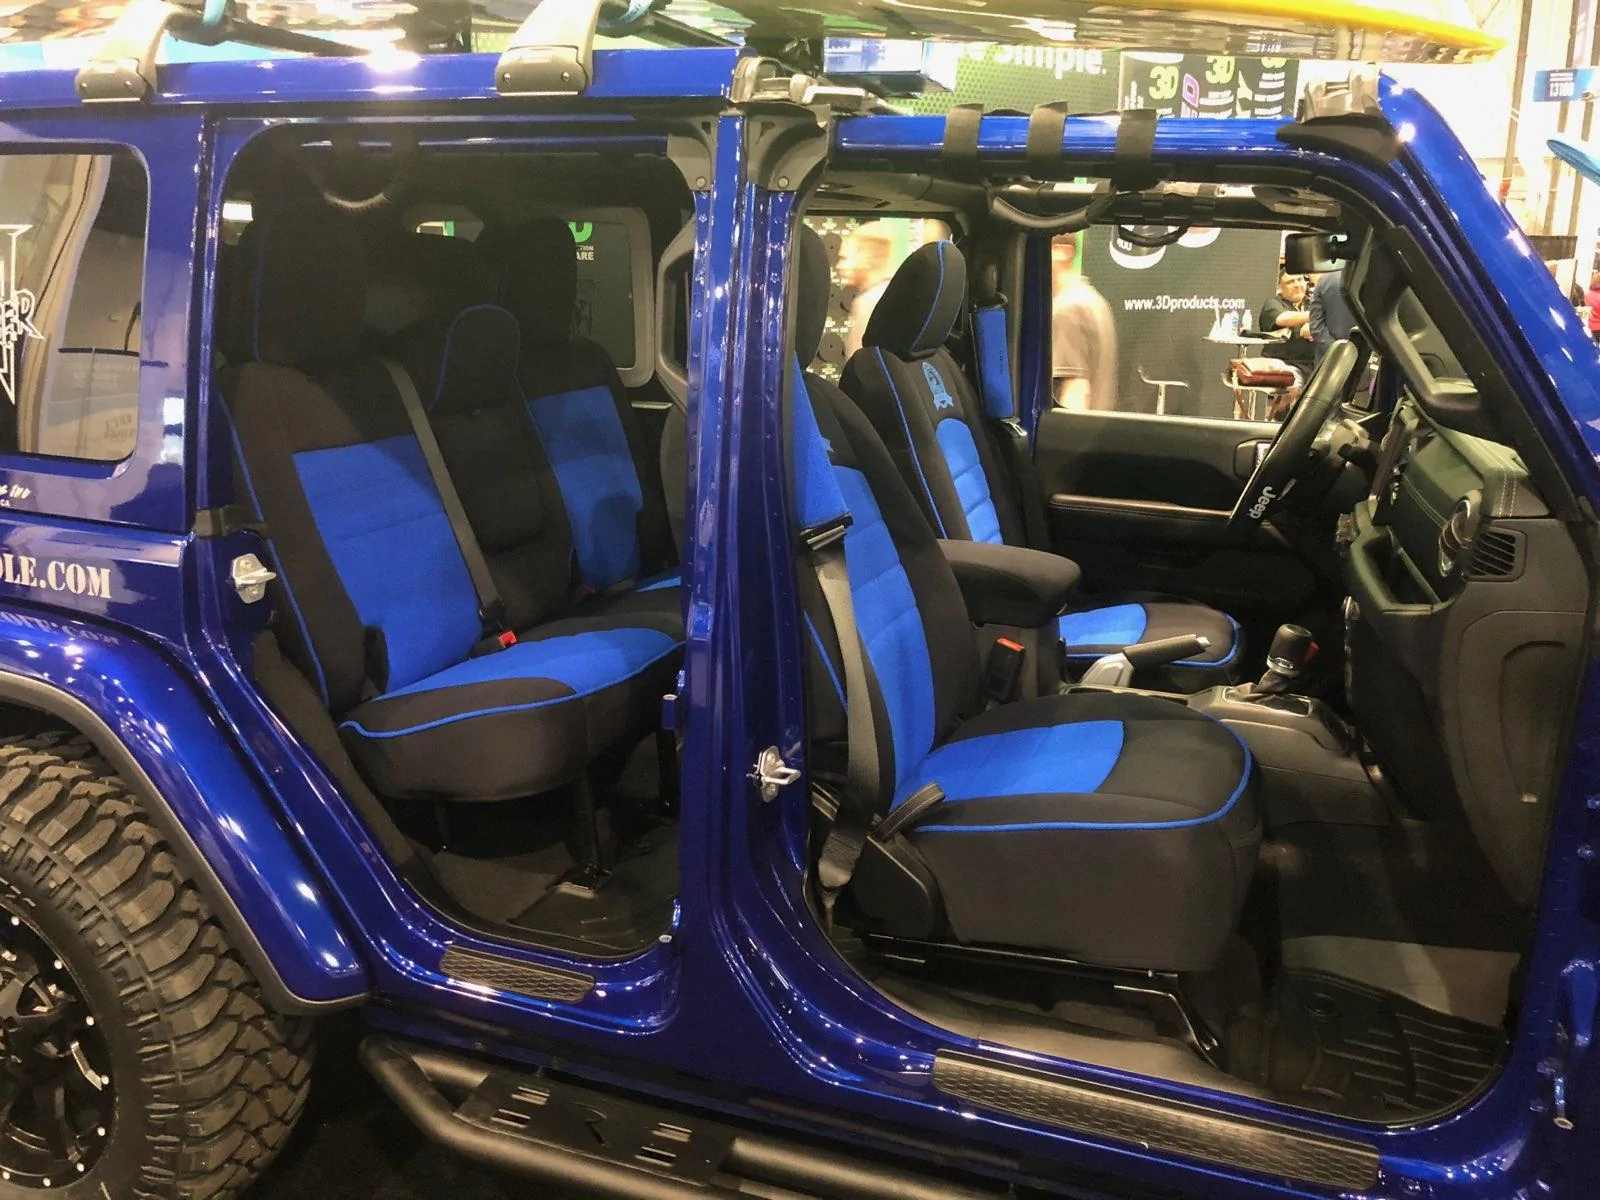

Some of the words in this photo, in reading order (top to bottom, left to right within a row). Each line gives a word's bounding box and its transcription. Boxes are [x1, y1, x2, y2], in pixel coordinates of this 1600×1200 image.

[1148, 65, 1180, 100] 3D
[1124, 294, 1246, 313] www.3Dproducts.com
[1249, 486, 1277, 519] Jeep
[0, 553, 112, 599] LE.COM
